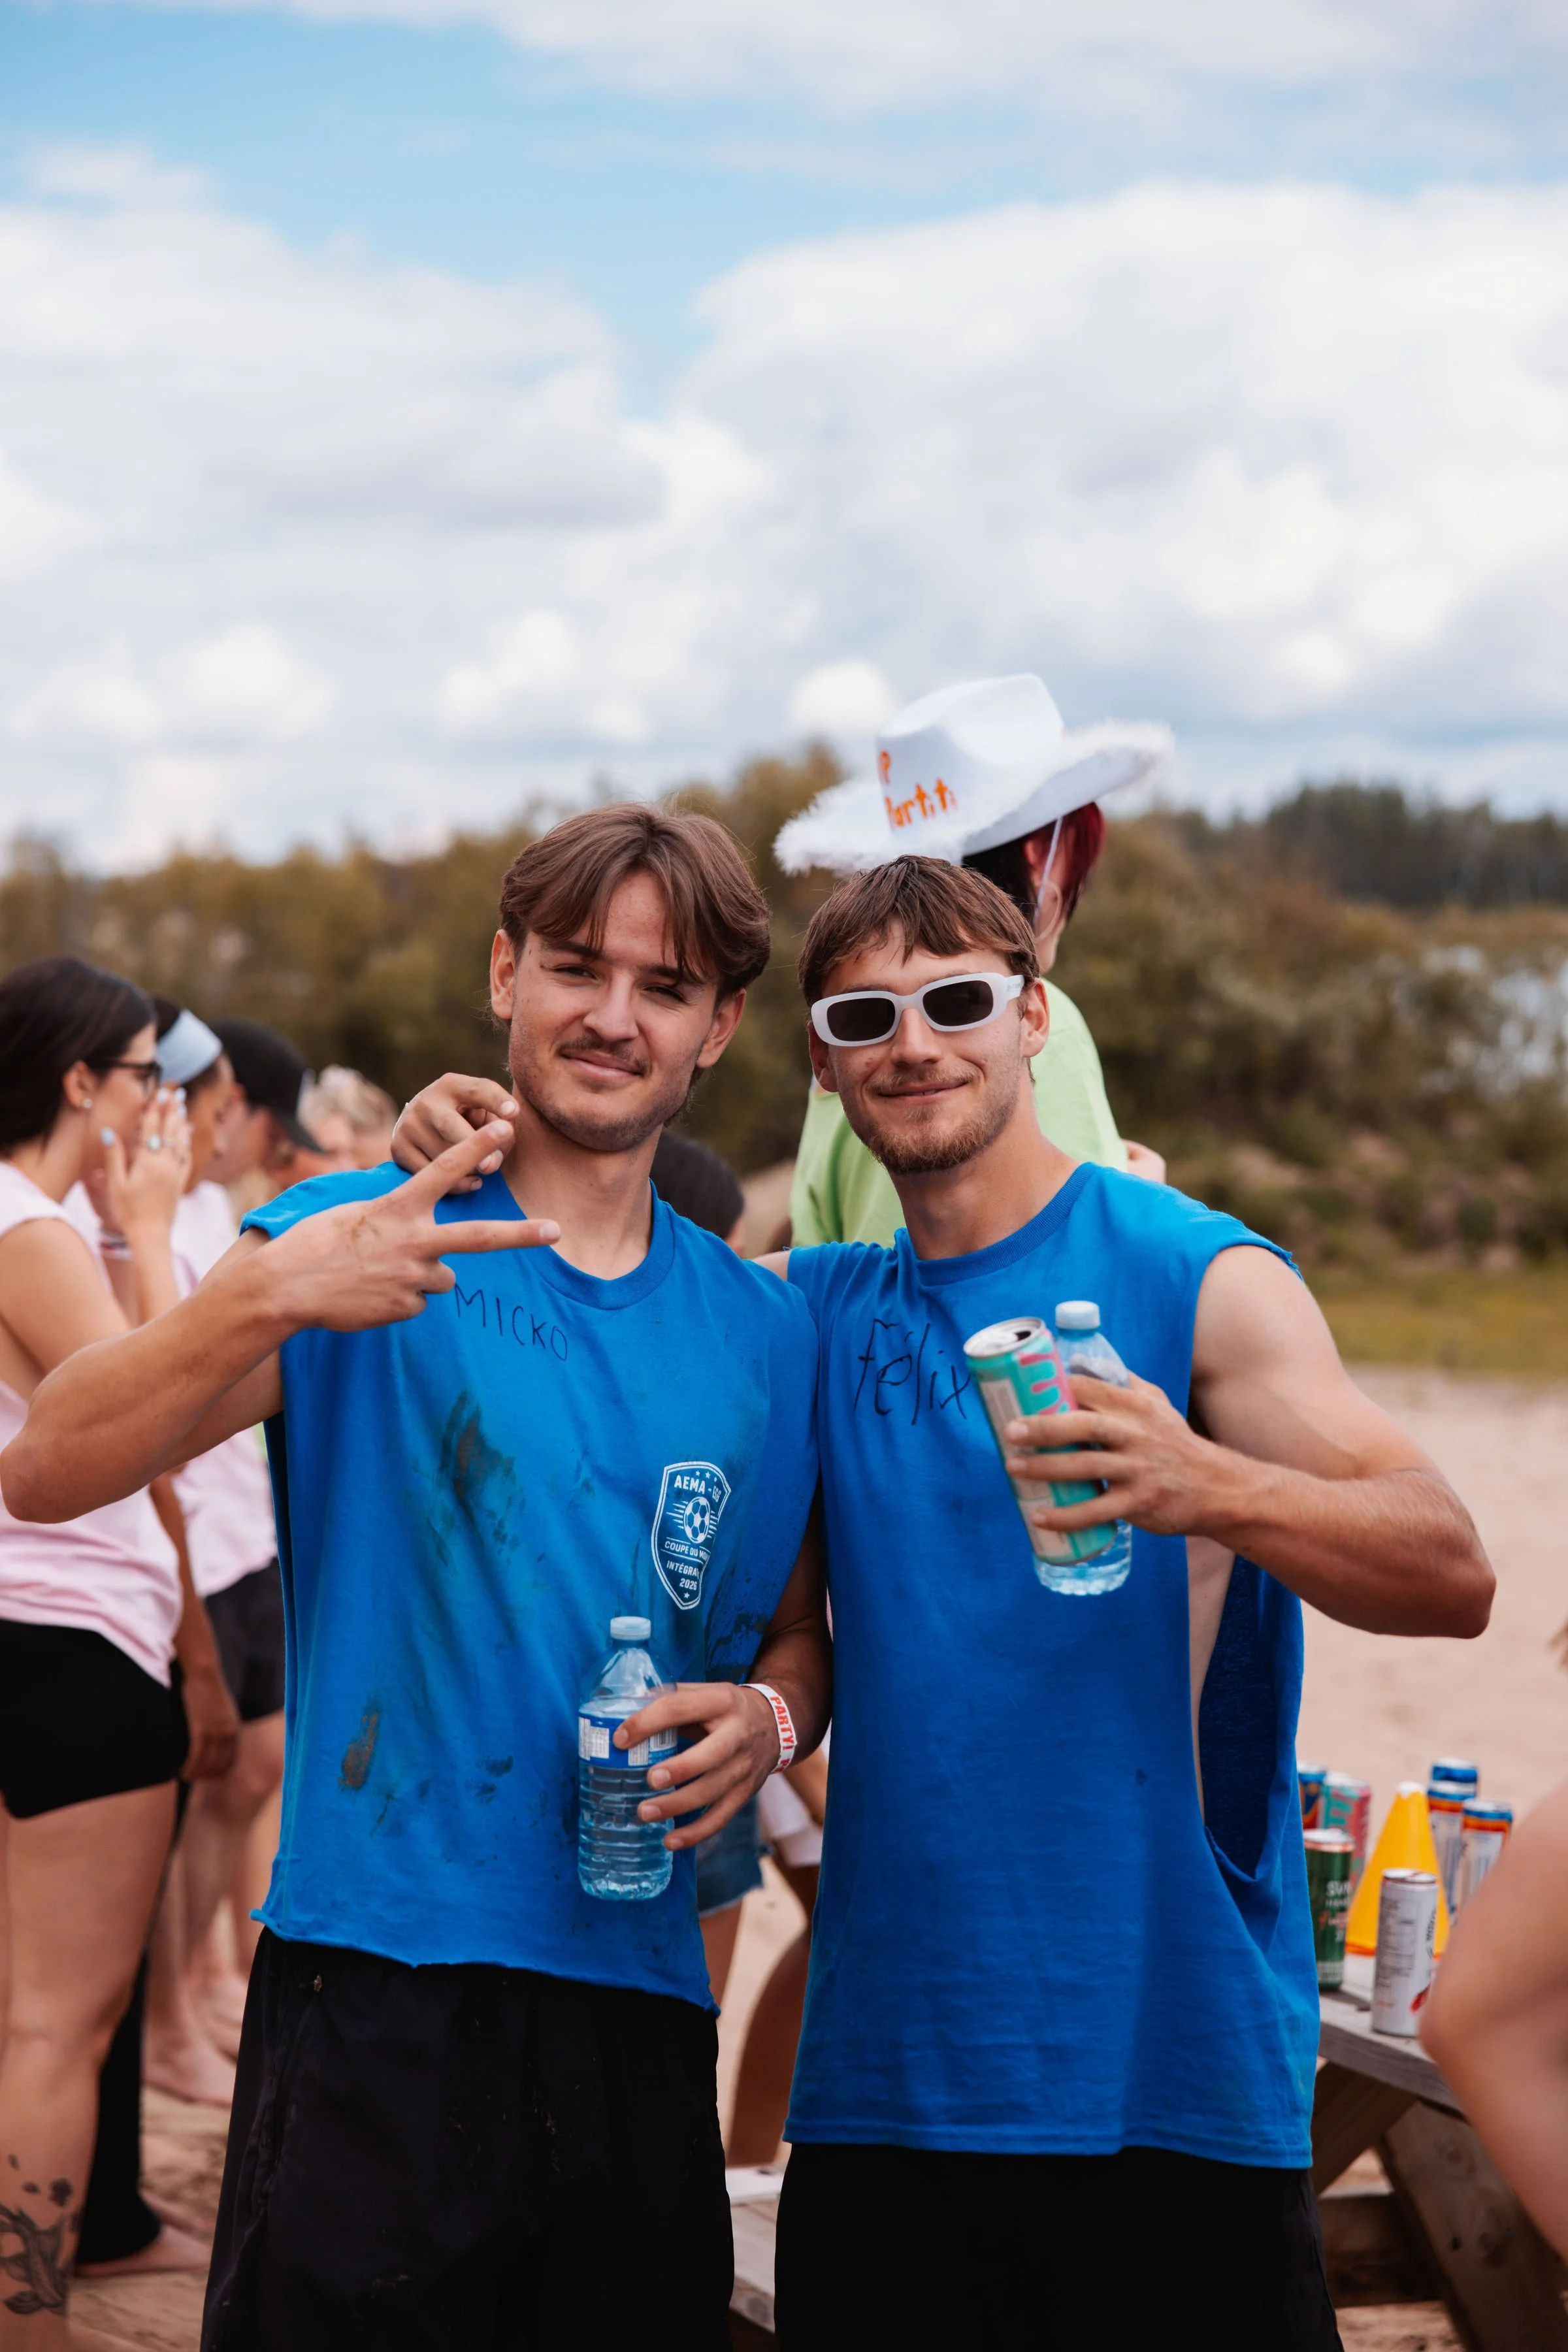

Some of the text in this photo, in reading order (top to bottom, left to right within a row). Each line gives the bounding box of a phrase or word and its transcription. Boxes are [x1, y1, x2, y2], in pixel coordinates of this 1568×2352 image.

[454, 1282, 568, 1362] MICKO
[674, 1475, 706, 1495] AEMA
[664, 1541, 689, 1554] COUPE
[689, 1547, 698, 1558] DU
[679, 1578, 698, 1591] 2026
[770, 1696, 794, 1751] PARTY!
